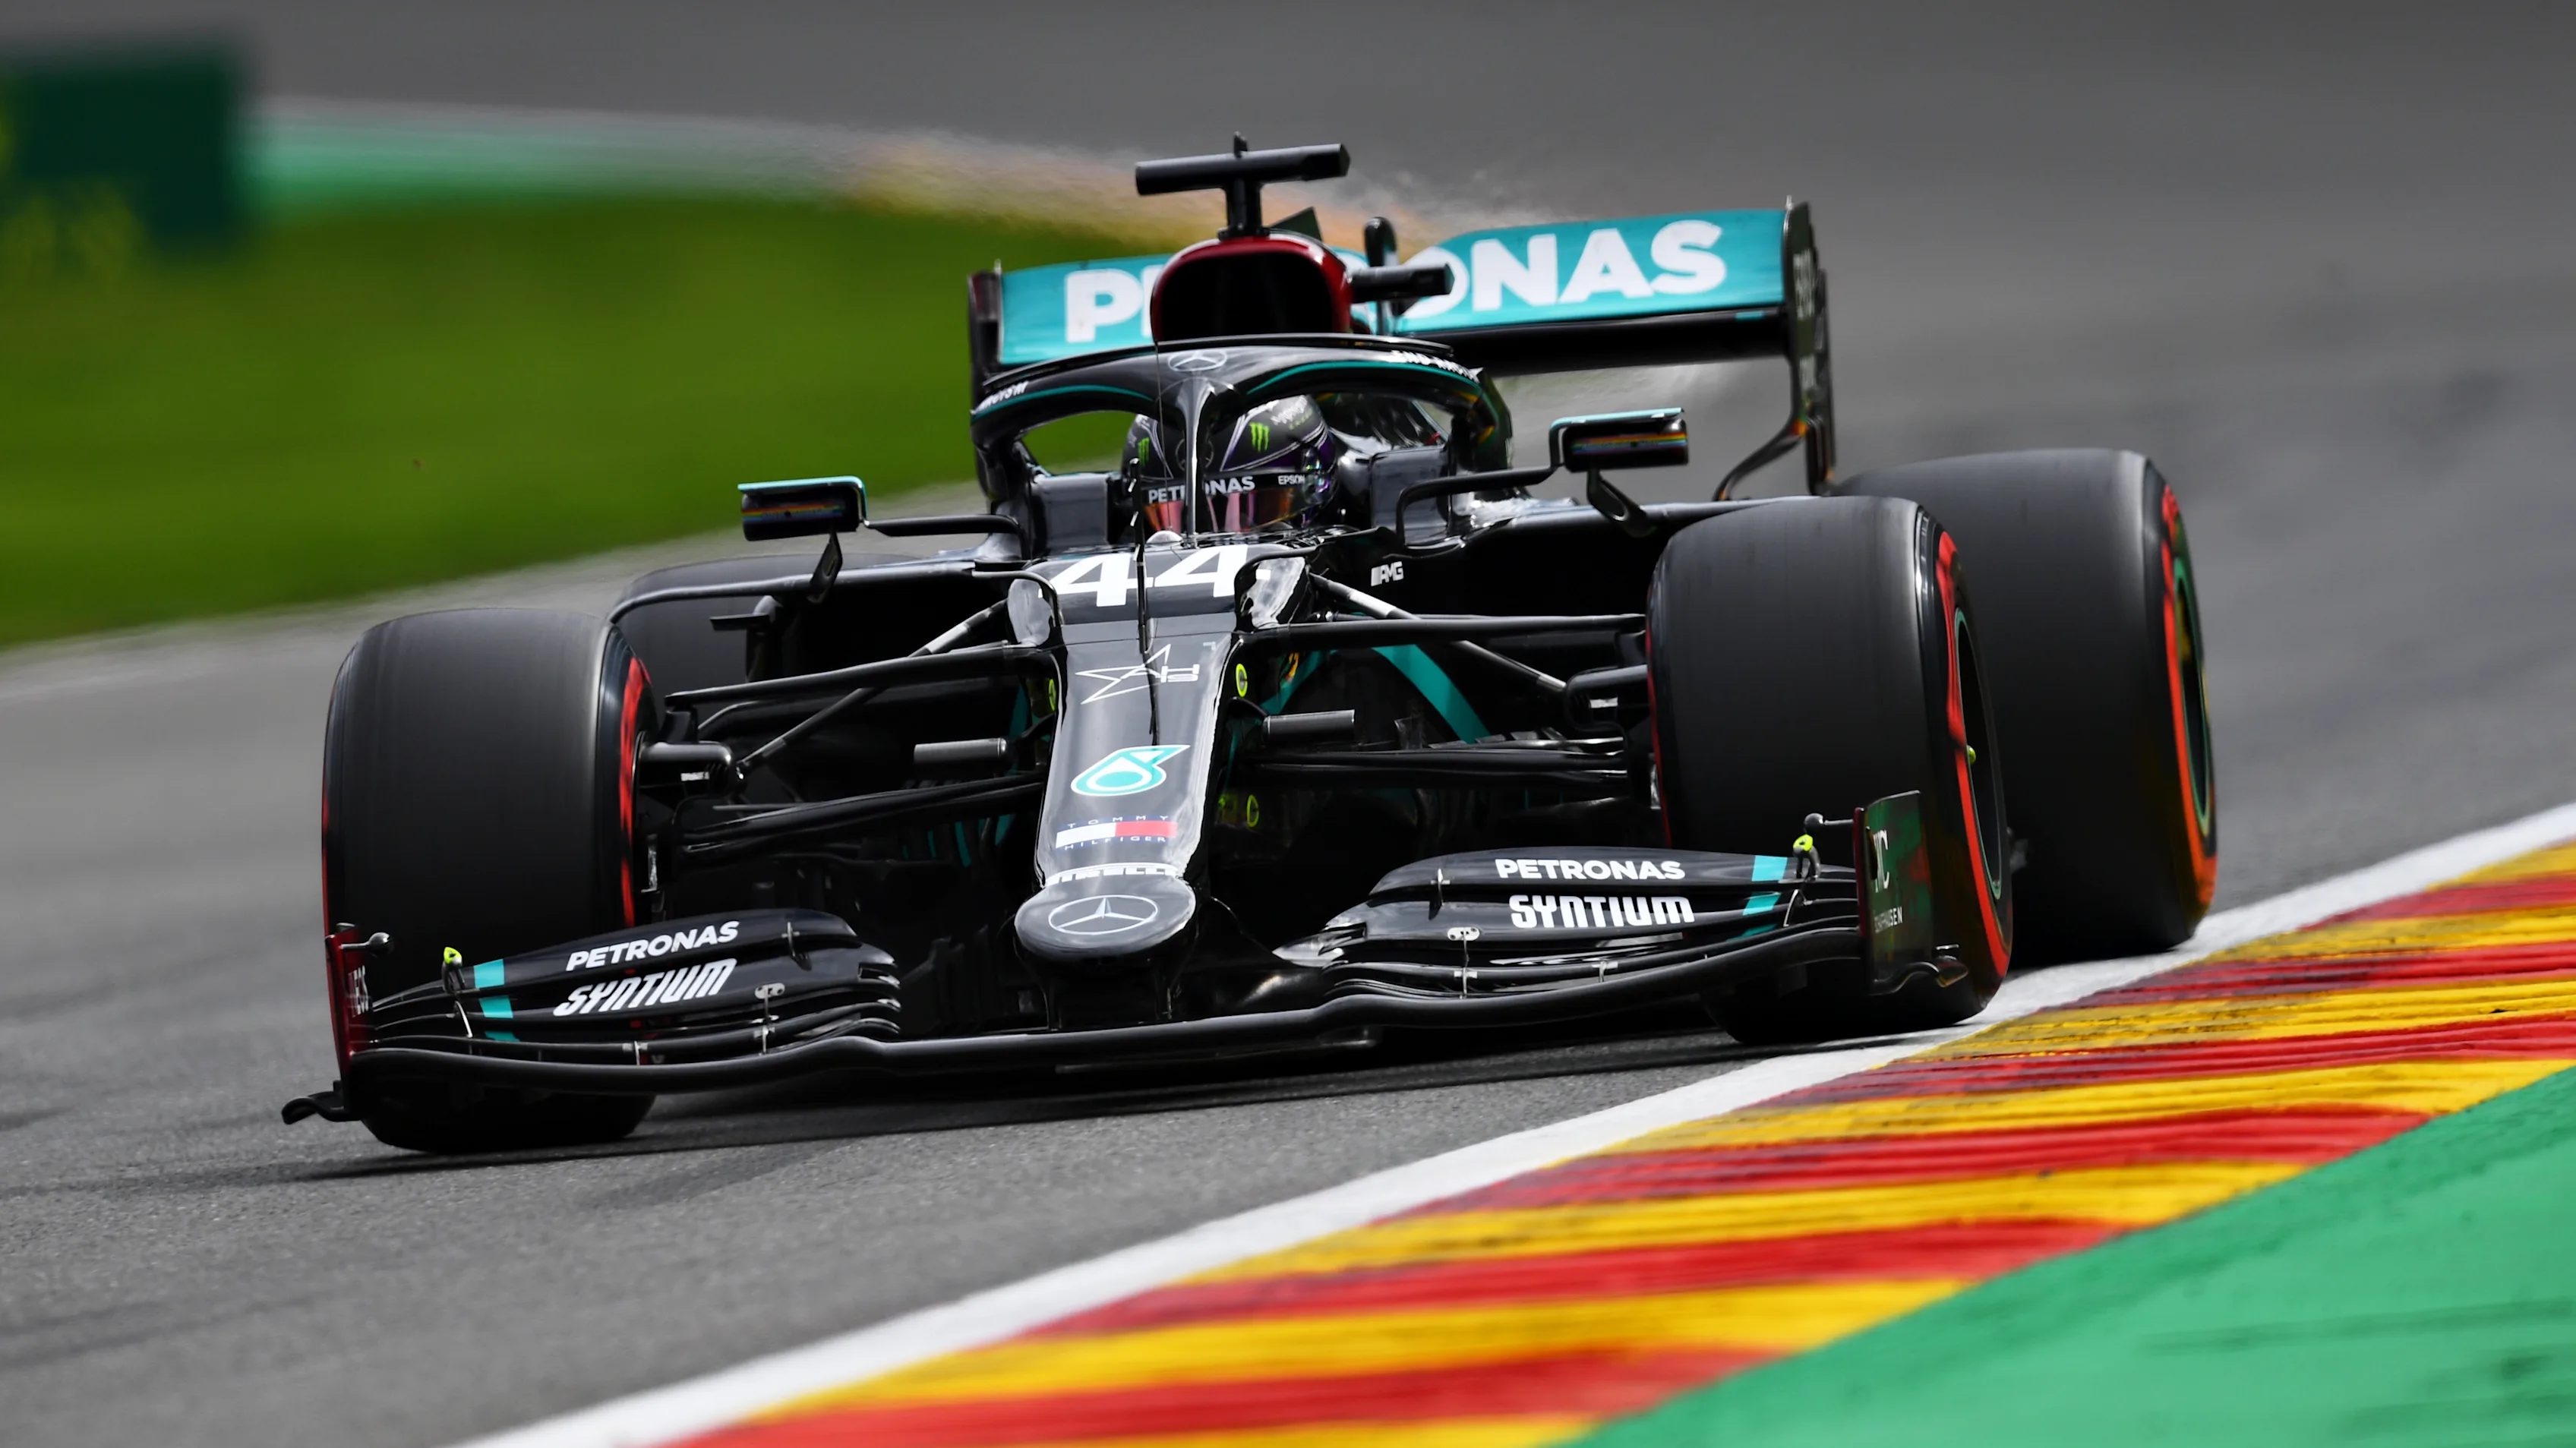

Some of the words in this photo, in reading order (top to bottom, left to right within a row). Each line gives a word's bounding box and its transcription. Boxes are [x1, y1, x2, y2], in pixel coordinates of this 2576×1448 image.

[1066, 219, 1727, 344] PONAS
[1148, 475, 1255, 504] PETNAS
[1277, 474, 1305, 486] EPSON
[1037, 544, 1271, 607] 44
[1375, 561, 1404, 585] AMG
[1067, 815, 1169, 829] TOMMY
[1064, 835, 1166, 851] HILFIGER
[1495, 859, 1686, 880] PETRONAS
[1509, 894, 1696, 929] SYNTIUM
[566, 920, 740, 971] PETRONAS
[553, 957, 737, 1016] SYNTIUM
